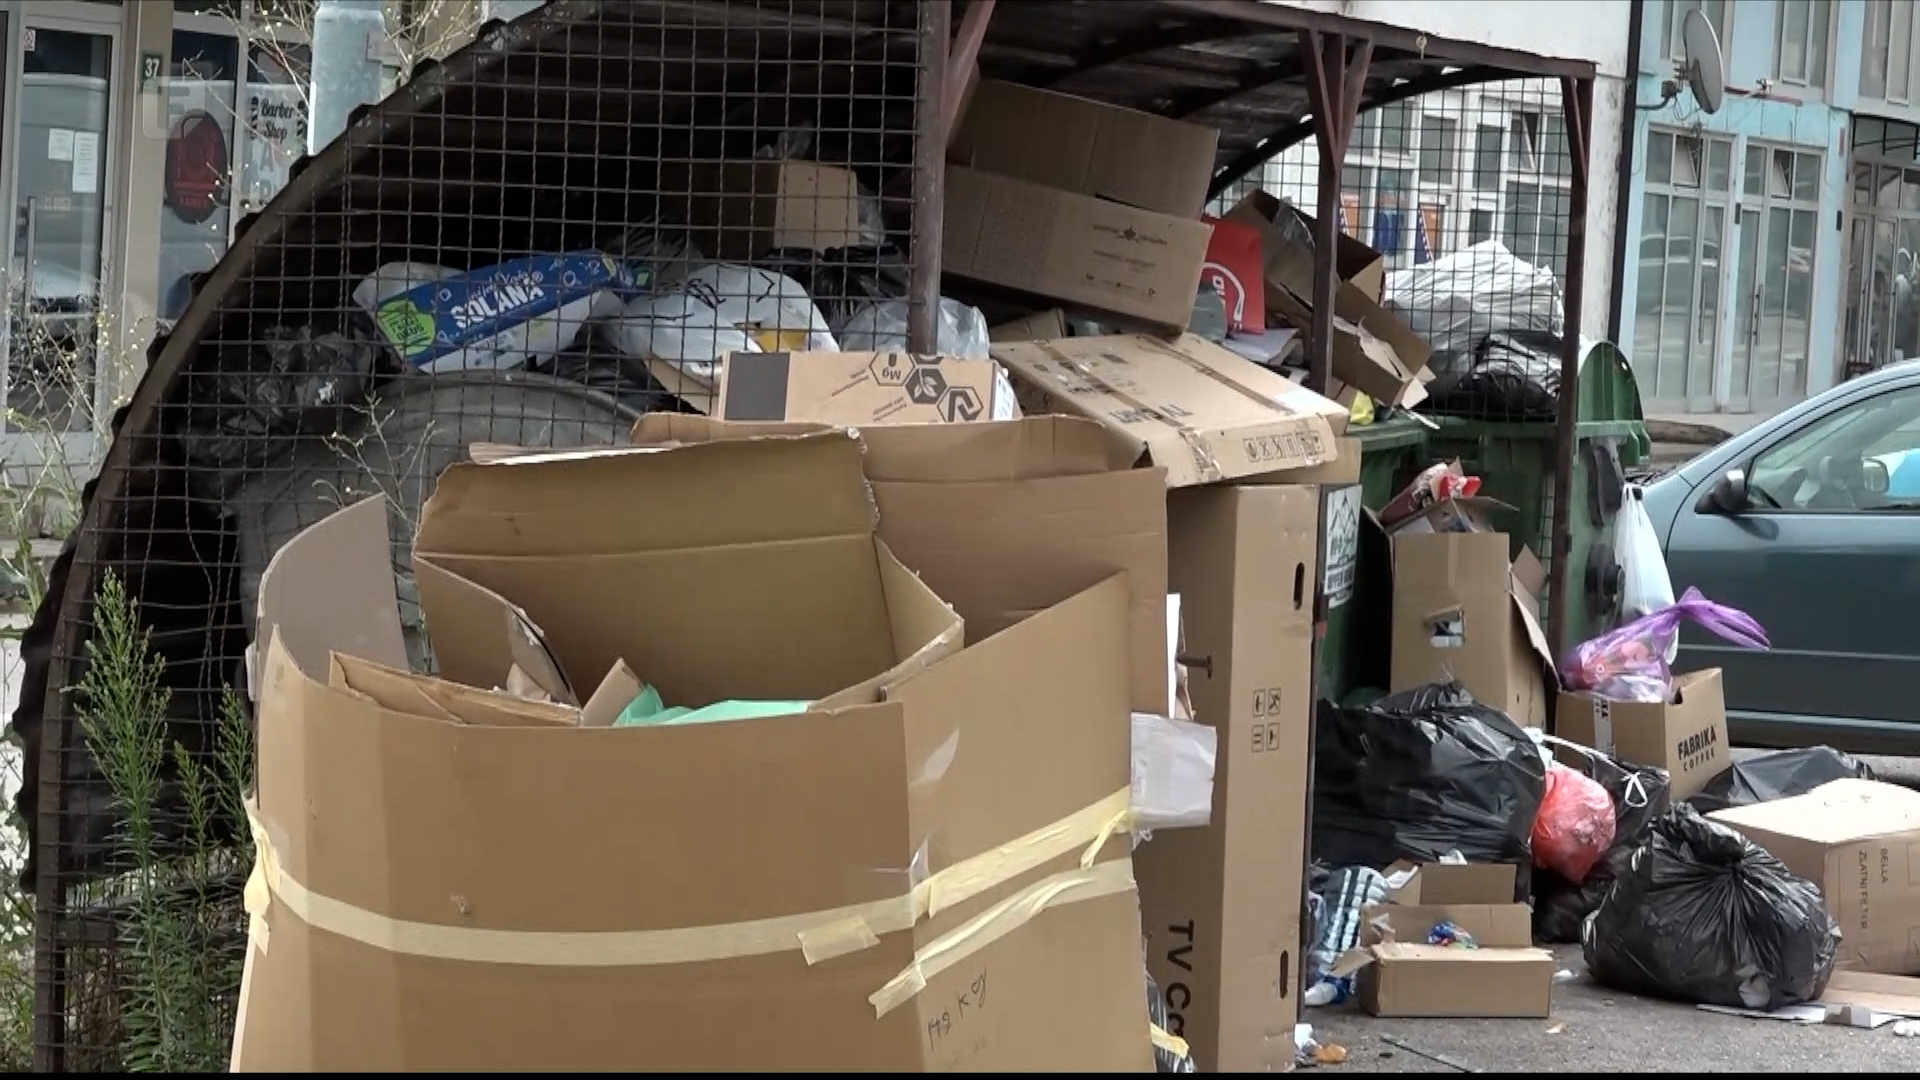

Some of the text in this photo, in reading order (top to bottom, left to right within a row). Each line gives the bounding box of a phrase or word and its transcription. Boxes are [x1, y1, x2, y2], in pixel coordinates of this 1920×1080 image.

[145, 57, 160, 79] 37
[260, 98, 295, 119] Barber
[264, 121, 288, 144] Shop
[450, 279, 545, 329] SOLANA
[881, 369, 902, 381] Mg
[1677, 725, 1717, 761] FABRIKA
[1683, 747, 1715, 773] COFFEE
[1858, 850, 1868, 889] ZLATNI
[1880, 848, 1889, 884] BELLA
[1167, 919, 1194, 972] TV
